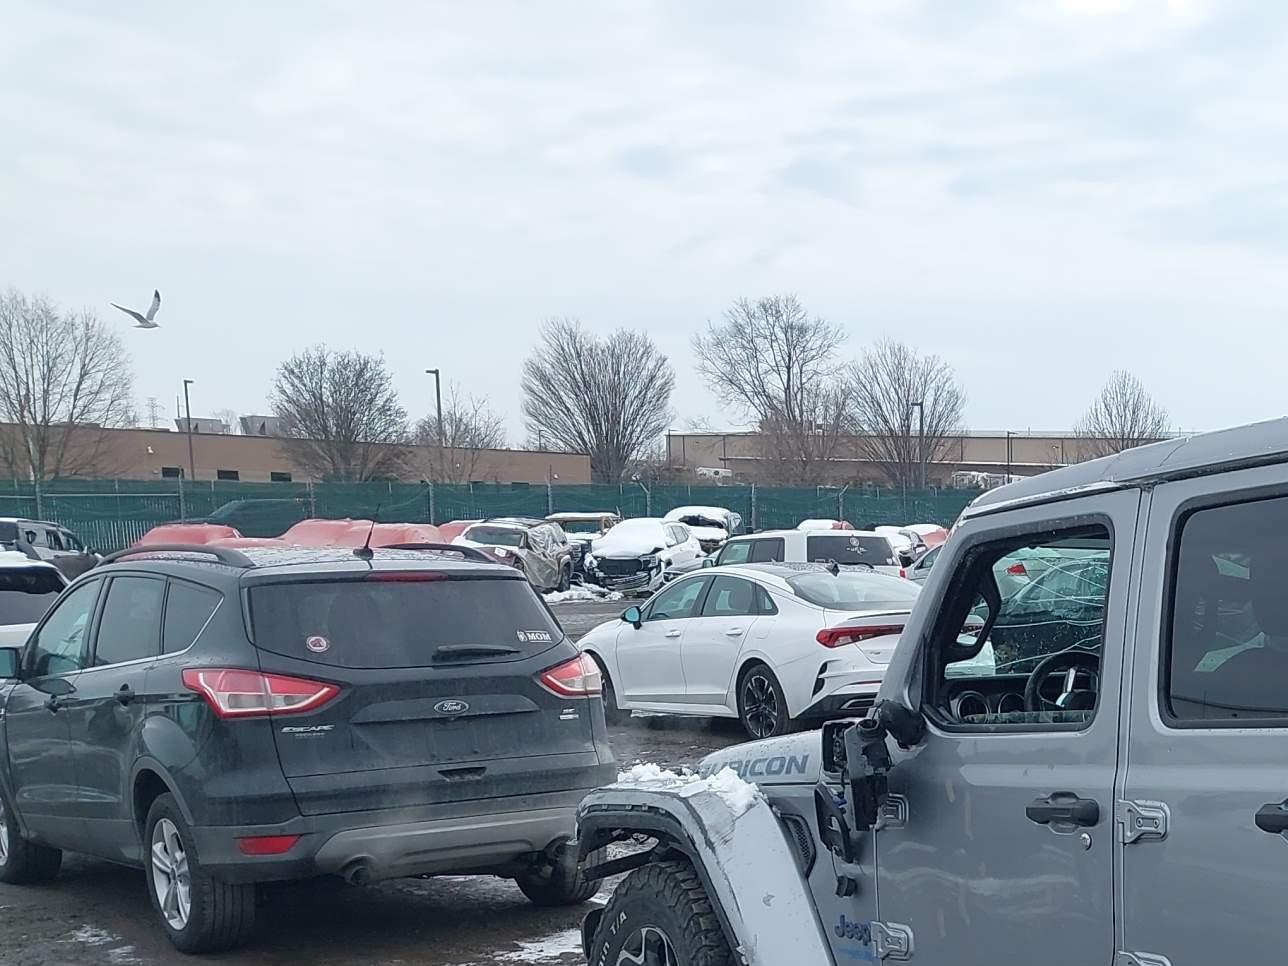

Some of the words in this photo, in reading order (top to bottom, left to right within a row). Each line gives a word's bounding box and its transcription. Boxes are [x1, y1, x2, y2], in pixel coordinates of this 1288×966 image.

[526, 631, 552, 641] MOM
[609, 911, 628, 936] T/A
[834, 914, 872, 947] Jeep
